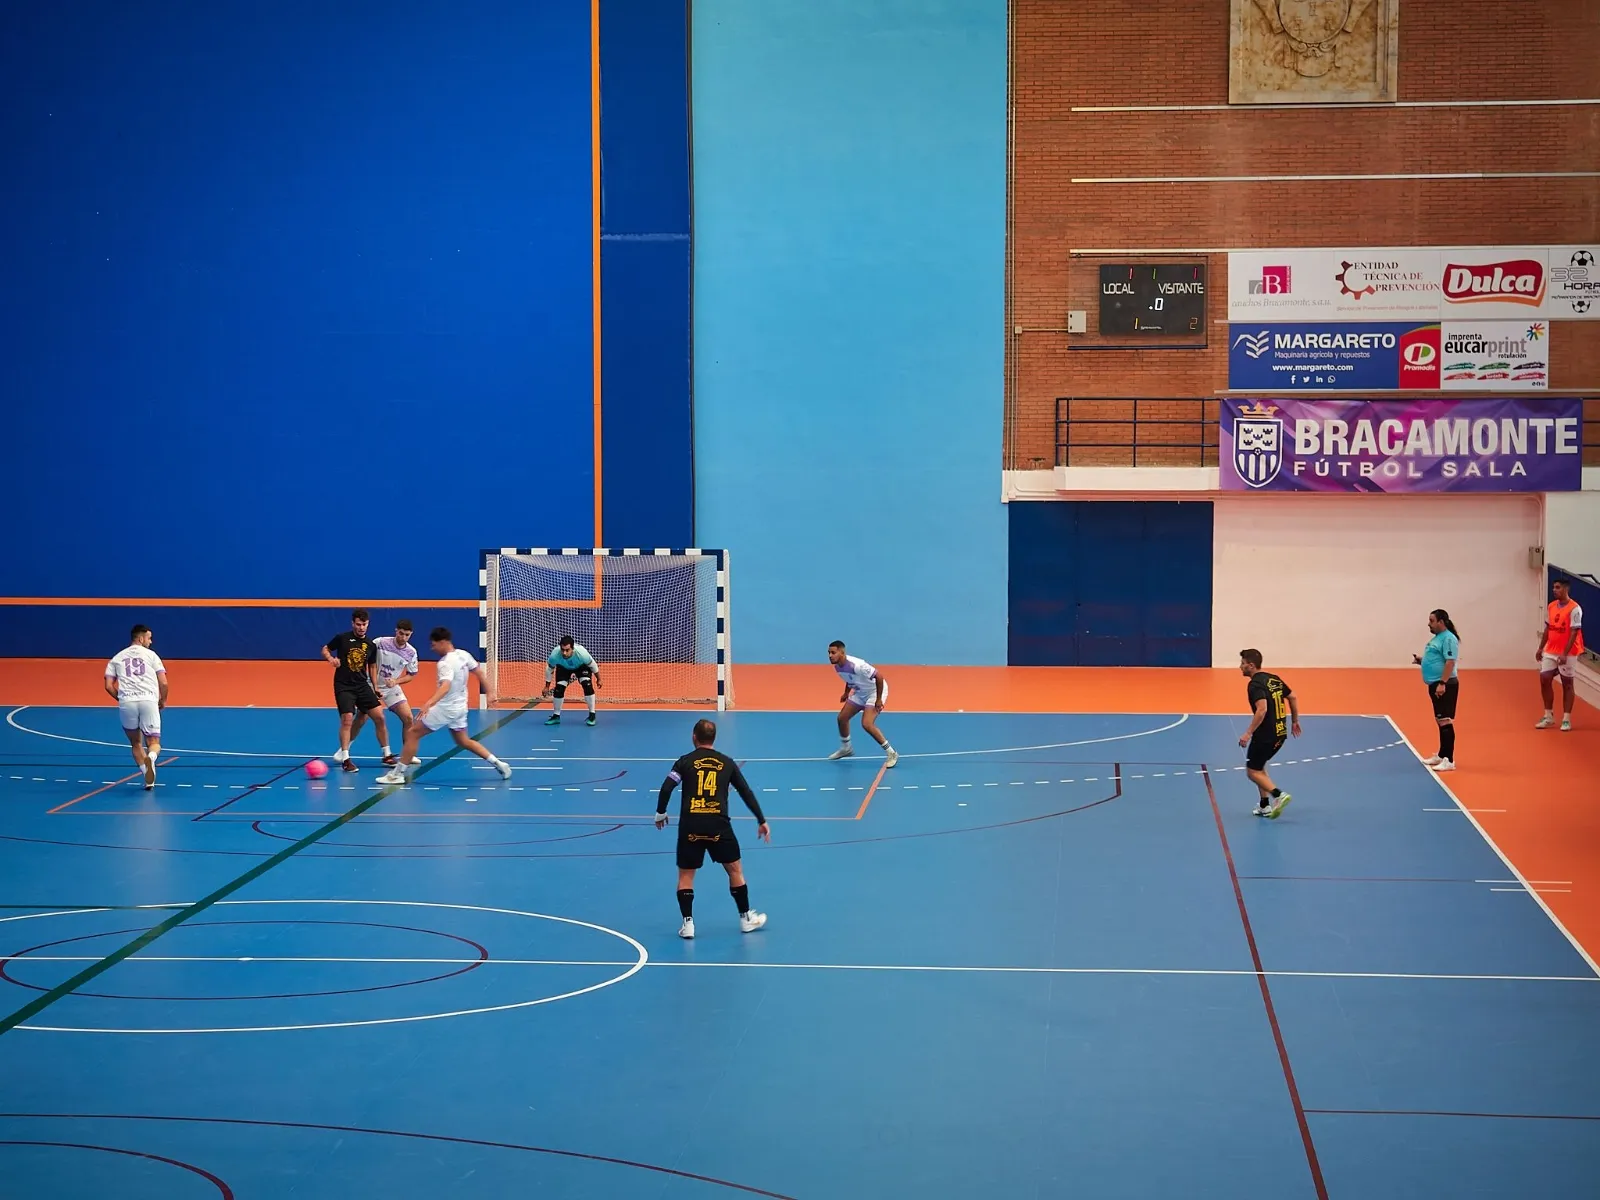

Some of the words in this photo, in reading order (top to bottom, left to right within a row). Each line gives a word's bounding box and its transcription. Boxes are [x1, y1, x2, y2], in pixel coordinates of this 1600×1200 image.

[1354, 262, 1399, 270] ENTIDAD
[1363, 271, 1407, 280] TÉCNICA
[1448, 267, 1536, 294] Dulca
[1551, 267, 1588, 282] 32
[1103, 283, 1134, 294] LOCAL
[1158, 282, 1204, 294] VISITANTE
[1376, 282, 1440, 292] PREVENCIÓN
[1190, 317, 1198, 330] 2
[1274, 333, 1396, 349] MARGARETO
[1448, 333, 1482, 342] imprenta
[1274, 352, 1308, 360] Maquinaria
[1340, 352, 1370, 360] repuestos
[1272, 364, 1354, 372] www.margareto.com
[1294, 418, 1578, 456] BRACAMONTE
[1293, 458, 1424, 478] FÚTBOL
[1442, 461, 1528, 478] SALA
[122, 657, 146, 678] 19
[1272, 690, 1286, 720] 16
[696, 770, 717, 796] 14
[690, 797, 706, 810] jst
